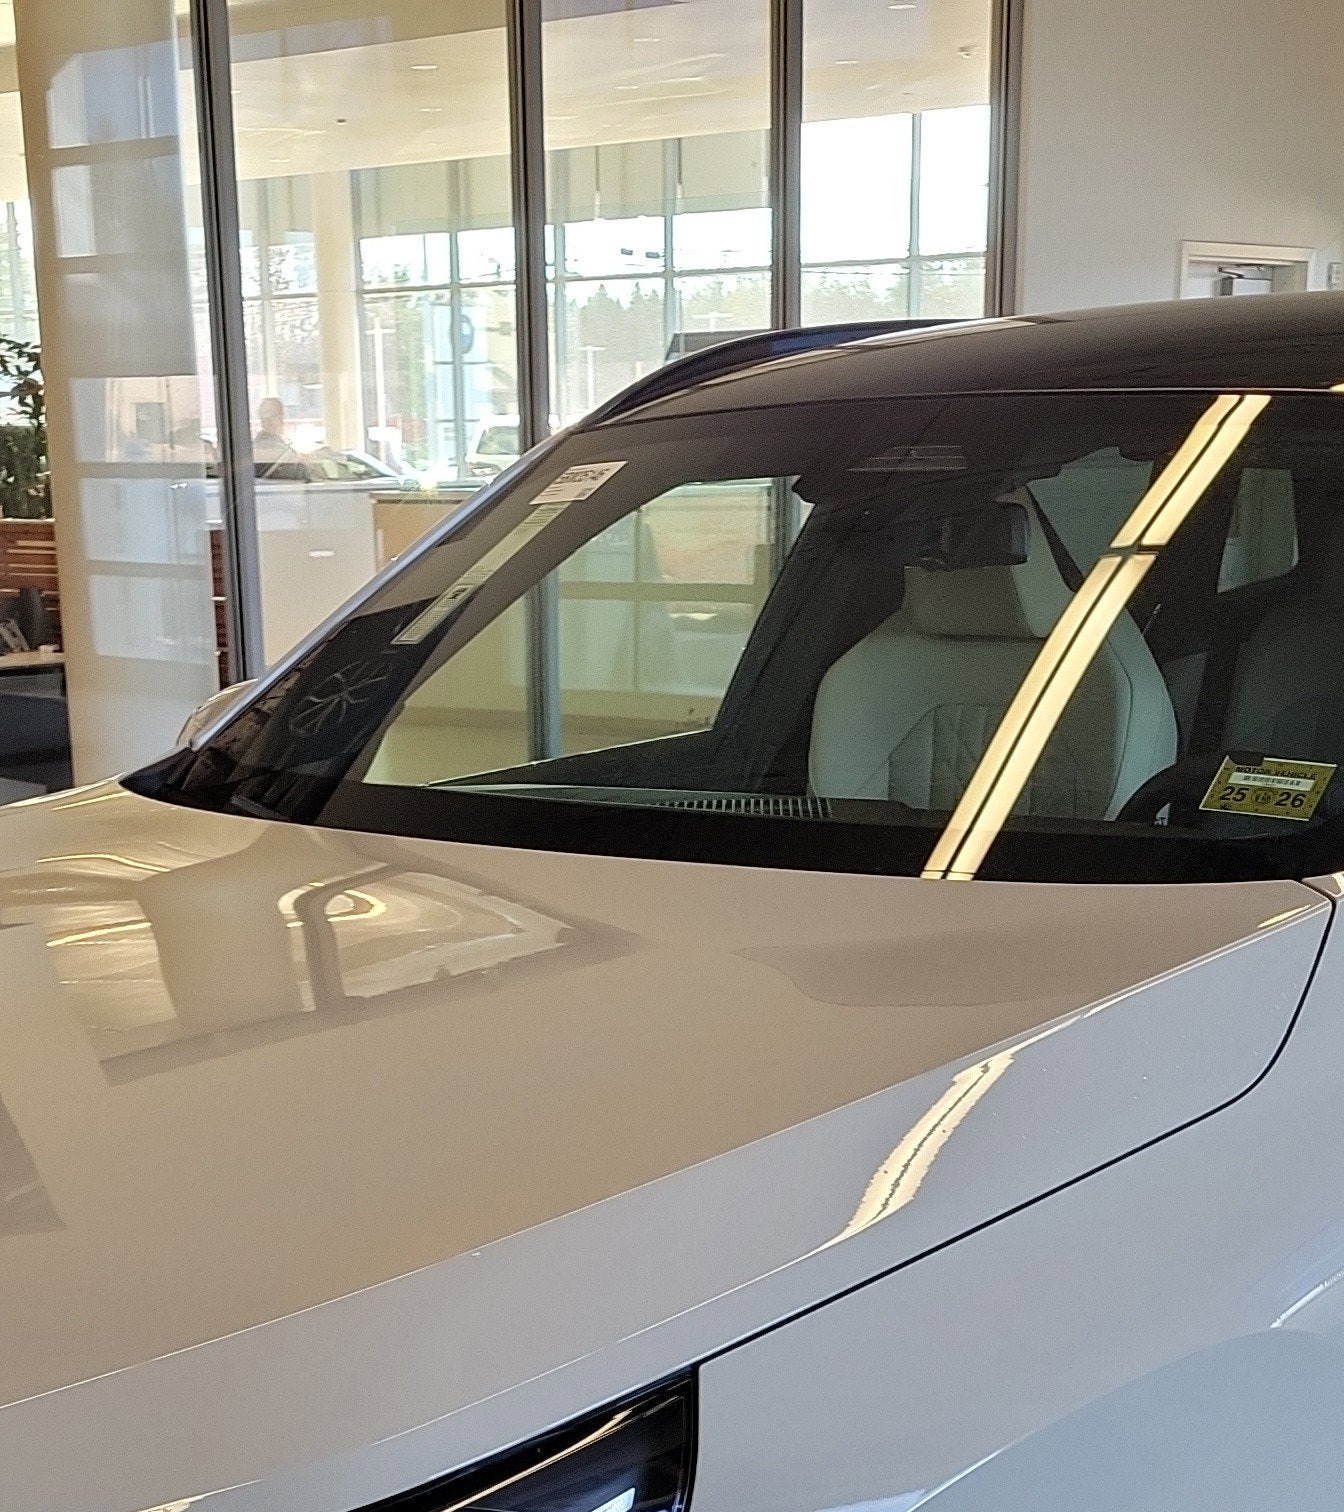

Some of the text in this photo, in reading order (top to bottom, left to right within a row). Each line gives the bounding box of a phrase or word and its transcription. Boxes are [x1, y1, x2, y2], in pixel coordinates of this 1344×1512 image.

[1236, 765, 1317, 780] MOTOR VEHICLE
[1219, 785, 1249, 802] 25
[1274, 791, 1307, 808] 26
